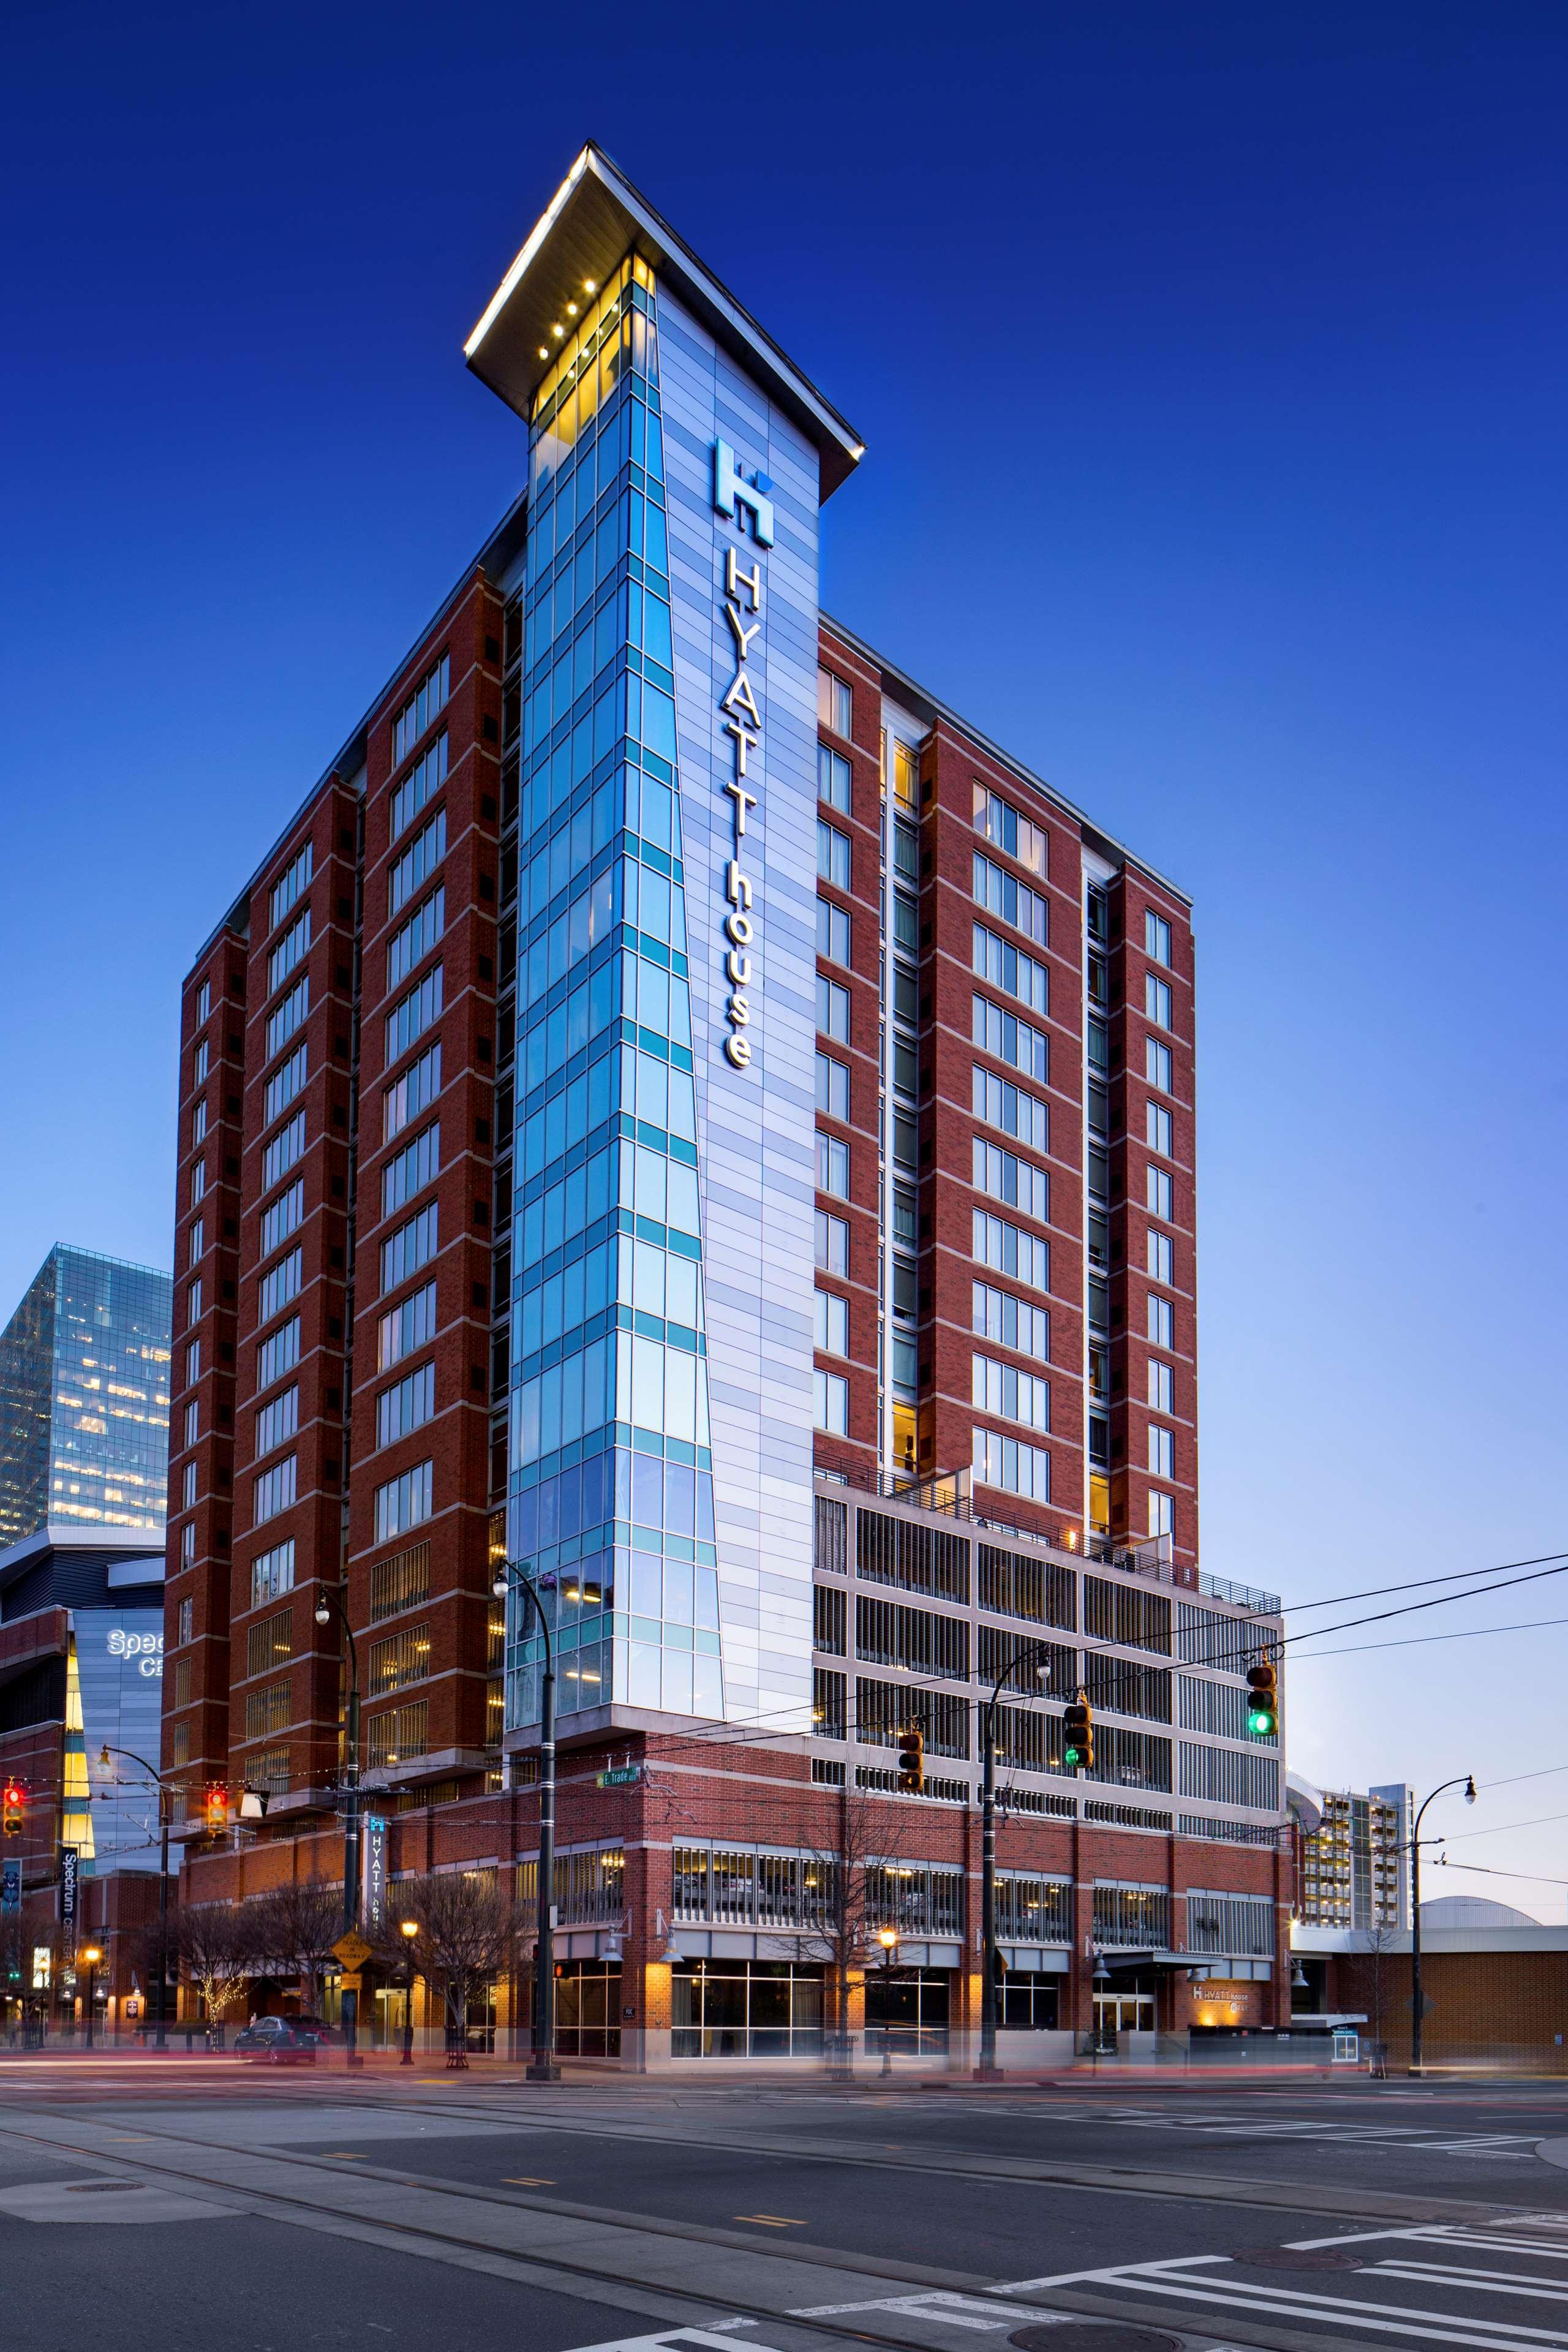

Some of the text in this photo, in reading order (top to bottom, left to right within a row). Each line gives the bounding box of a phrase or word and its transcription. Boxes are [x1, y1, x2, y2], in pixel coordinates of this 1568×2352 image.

[722, 546, 762, 837] HYATT
[726, 859, 753, 1069] house
[612, 1771, 628, 1783] Trade
[62, 1854, 77, 1912] Spectrum
[372, 1836, 381, 1893] HYATT
[1204, 1990, 1231, 2000] HYATT
[1231, 1992, 1248, 2000] house
